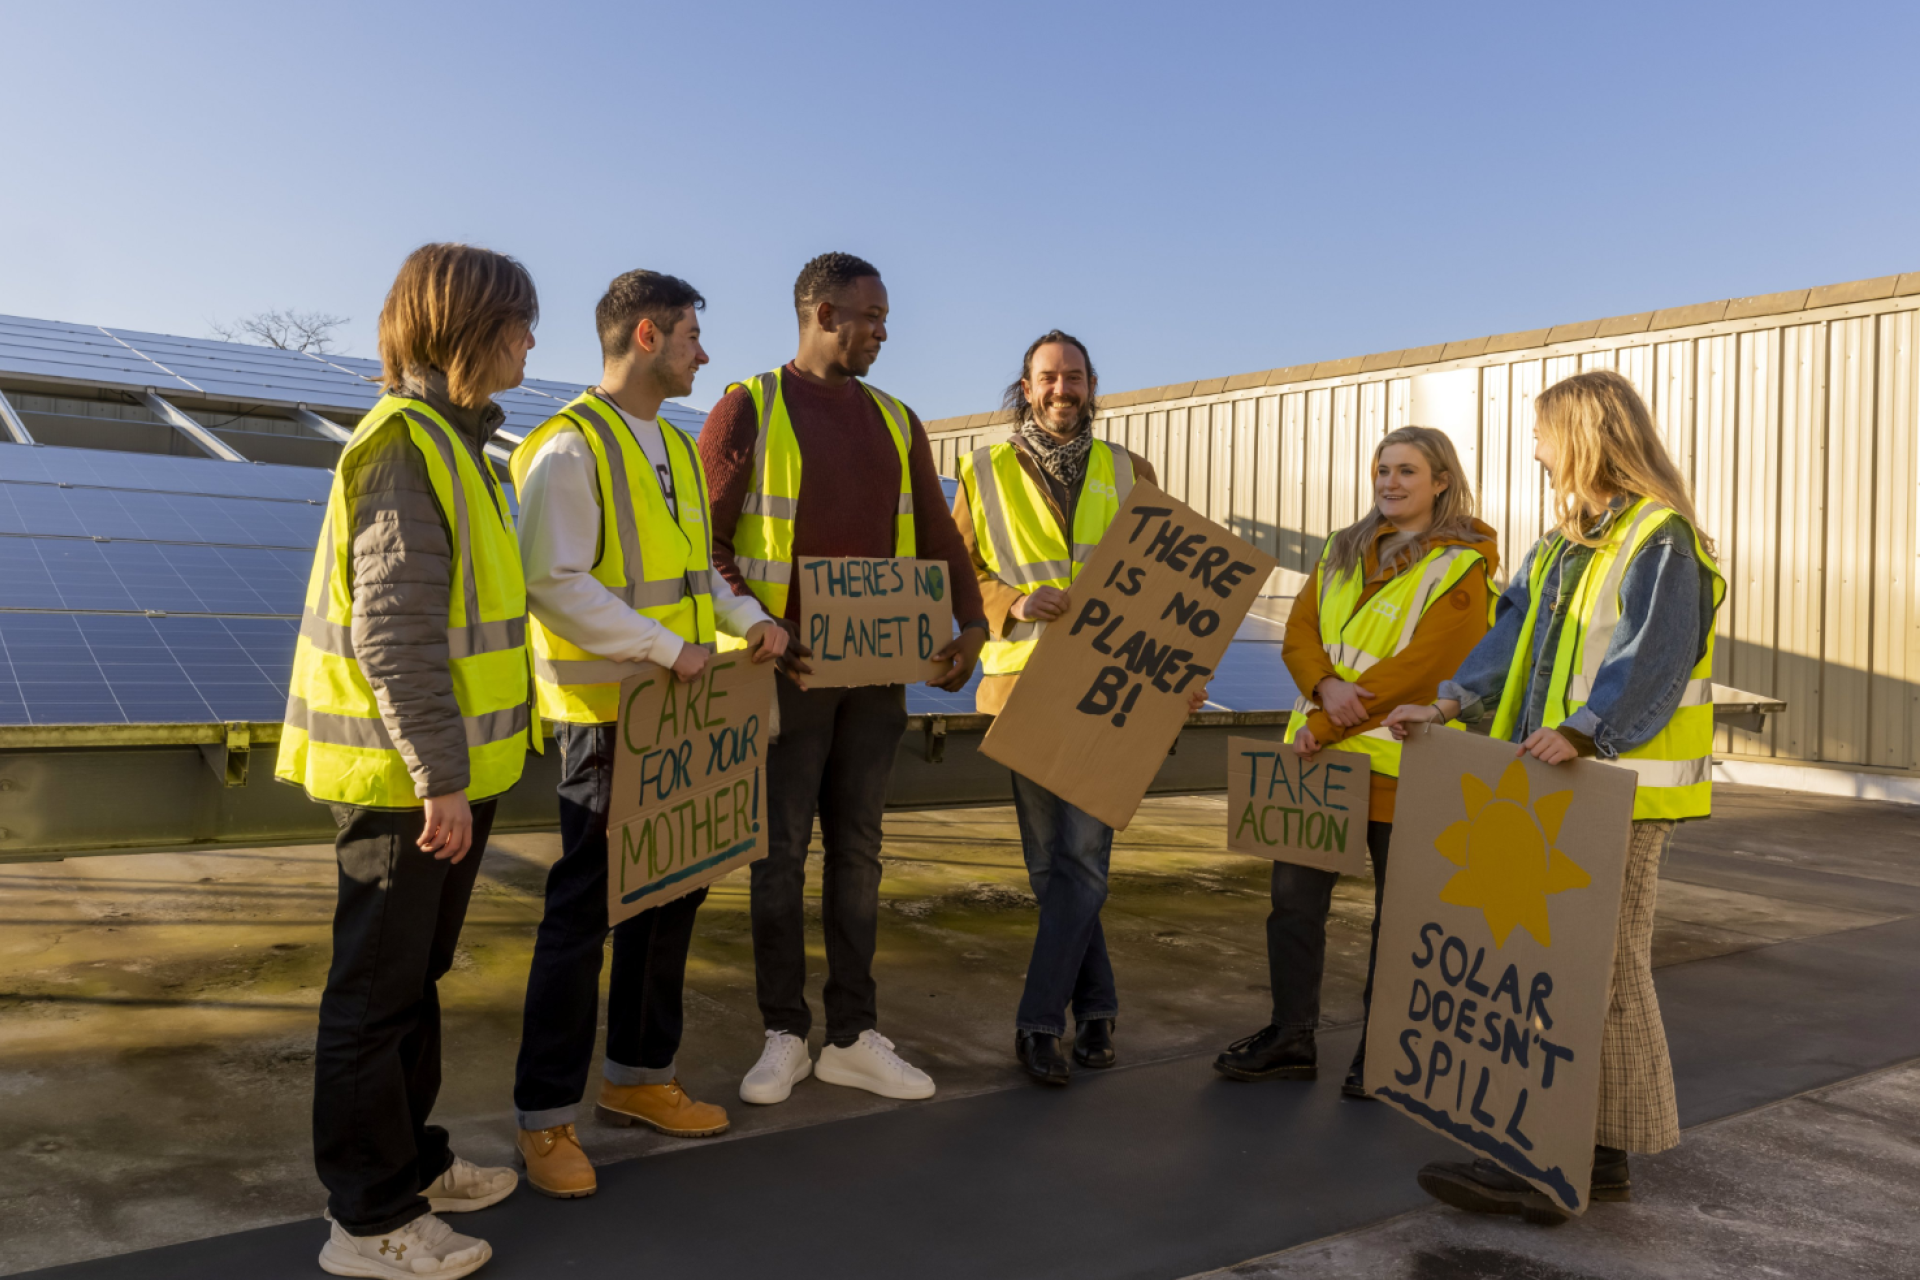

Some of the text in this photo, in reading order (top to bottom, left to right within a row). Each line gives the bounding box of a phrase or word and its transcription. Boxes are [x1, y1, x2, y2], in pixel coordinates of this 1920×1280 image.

[915, 565, 944, 601] NO
[1130, 506, 1256, 598] THERE
[810, 613, 933, 661] PLANET B
[1103, 560, 1220, 638] IS NO
[1069, 598, 1211, 694] PLANET
[623, 661, 736, 755] CARE
[1076, 665, 1143, 728] B!
[639, 714, 759, 806] FOR YOUR
[1241, 752, 1353, 811] TAKE
[620, 766, 760, 893] MOTHER!
[1236, 801, 1349, 853] ACTION
[1411, 922, 1553, 1030] SOLAR
[1408, 978, 1574, 1089] DOESN'T
[1394, 1028, 1533, 1151] SPILL
